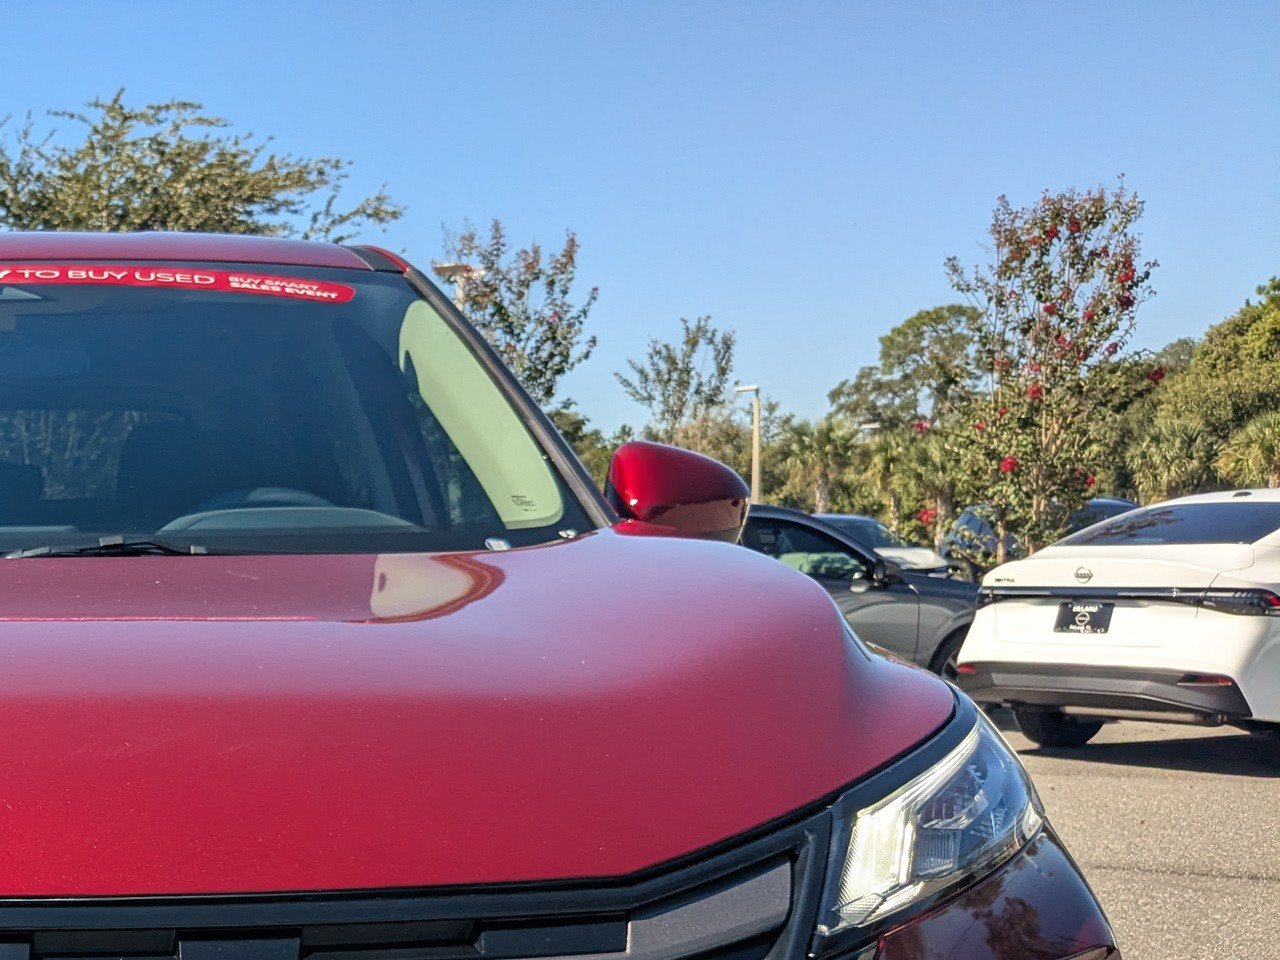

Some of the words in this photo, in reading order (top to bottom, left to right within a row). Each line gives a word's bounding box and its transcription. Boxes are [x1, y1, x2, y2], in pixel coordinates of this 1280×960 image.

[15, 269, 61, 280] TO
[67, 269, 129, 282] BUY
[134, 271, 216, 285] USED
[284, 287, 338, 299] EVENT
